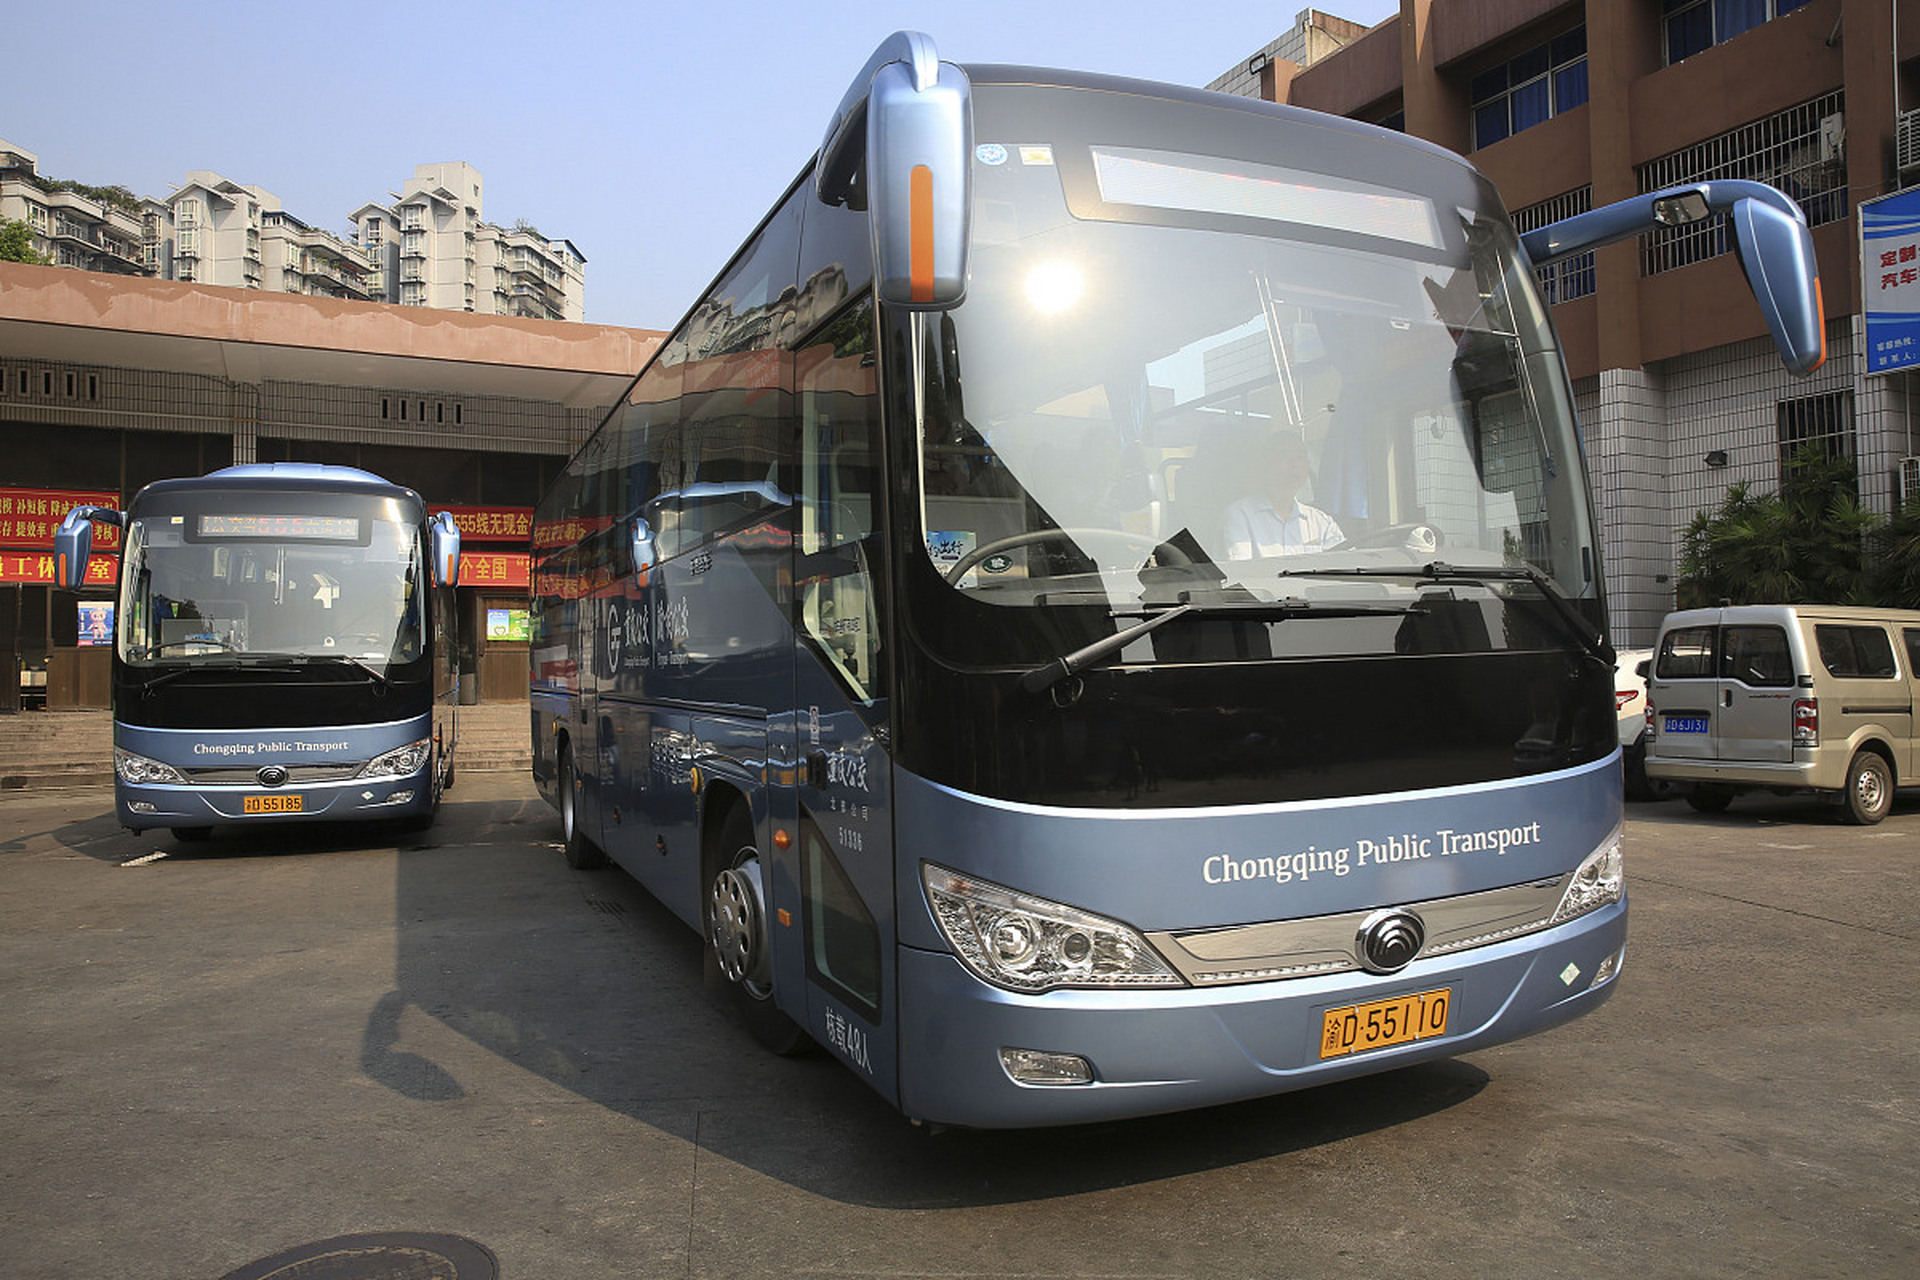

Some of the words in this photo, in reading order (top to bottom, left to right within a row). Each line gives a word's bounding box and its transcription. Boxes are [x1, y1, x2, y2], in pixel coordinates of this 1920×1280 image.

[1880, 244, 1920, 268] 定制
[1881, 266, 1920, 290] 汽车
[453, 512, 534, 535] 555线无现金
[193, 743, 255, 756] Chongqing
[257, 742, 292, 752] Public
[294, 741, 349, 753] Transport
[1203, 846, 1349, 884] Chongqing
[1357, 833, 1431, 866] Public
[1437, 821, 1541, 858] Transport
